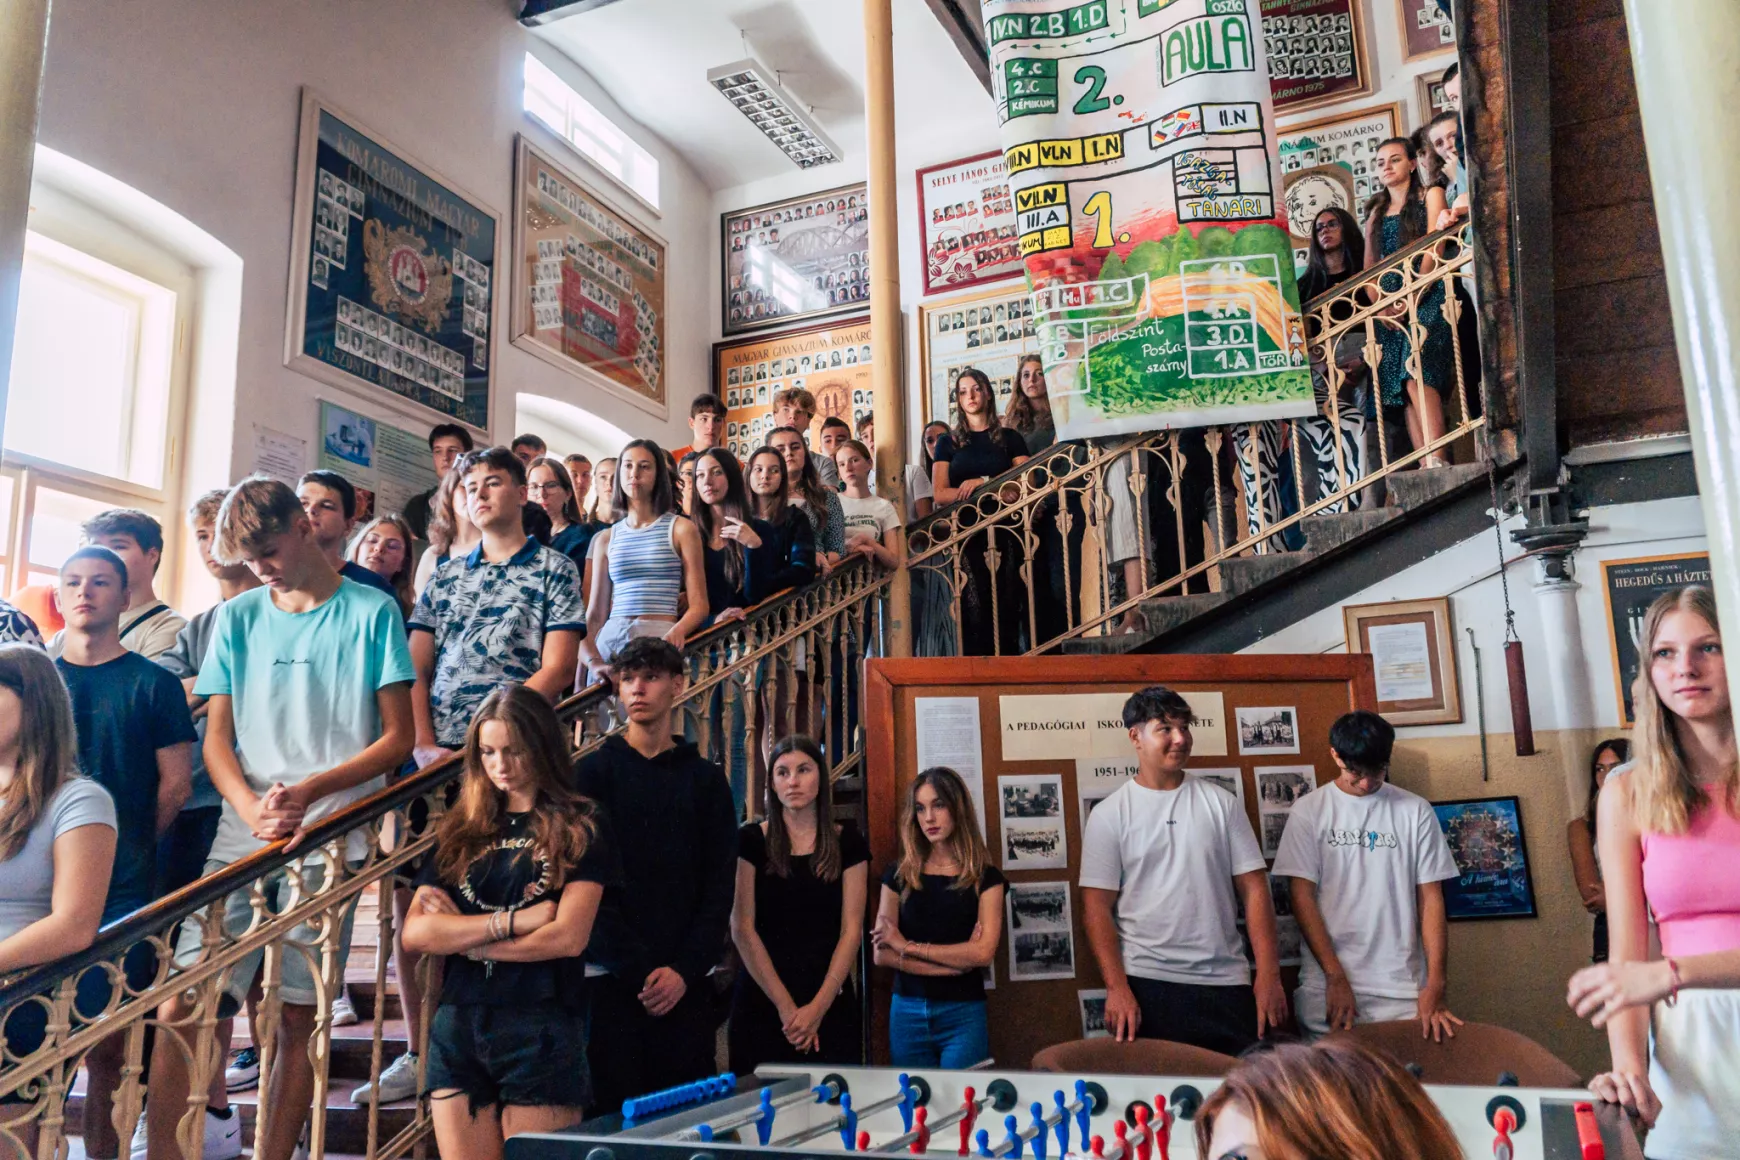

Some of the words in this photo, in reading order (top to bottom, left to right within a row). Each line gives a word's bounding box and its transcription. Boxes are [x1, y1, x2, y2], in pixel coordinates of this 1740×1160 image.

[1030, 13, 1065, 36] 2.B
[1072, 4, 1104, 29] 1.D
[1165, 17, 1249, 80] AULA
[1011, 62, 1042, 76] 4.C
[1304, 81, 1325, 94] 1975
[1219, 108, 1248, 127] II.N
[1328, 123, 1384, 142] KOMÁRNO
[1092, 136, 1119, 157] I.N
[932, 173, 958, 188] SELYE
[961, 166, 989, 182] JÁNOS
[1019, 187, 1057, 208] VII.N
[1186, 196, 1262, 218] TANÁRI
[1026, 210, 1060, 229] III.A
[732, 348, 770, 363] MAGYAR
[1214, 350, 1250, 370] 1.A
[1260, 355, 1287, 367] TÖR
[1615, 573, 1664, 589] HEGEDŰS
[1666, 574, 1673, 584] A
[1006, 723, 1014, 731] A
[1017, 719, 1086, 731] PEDAGÓGIAI
